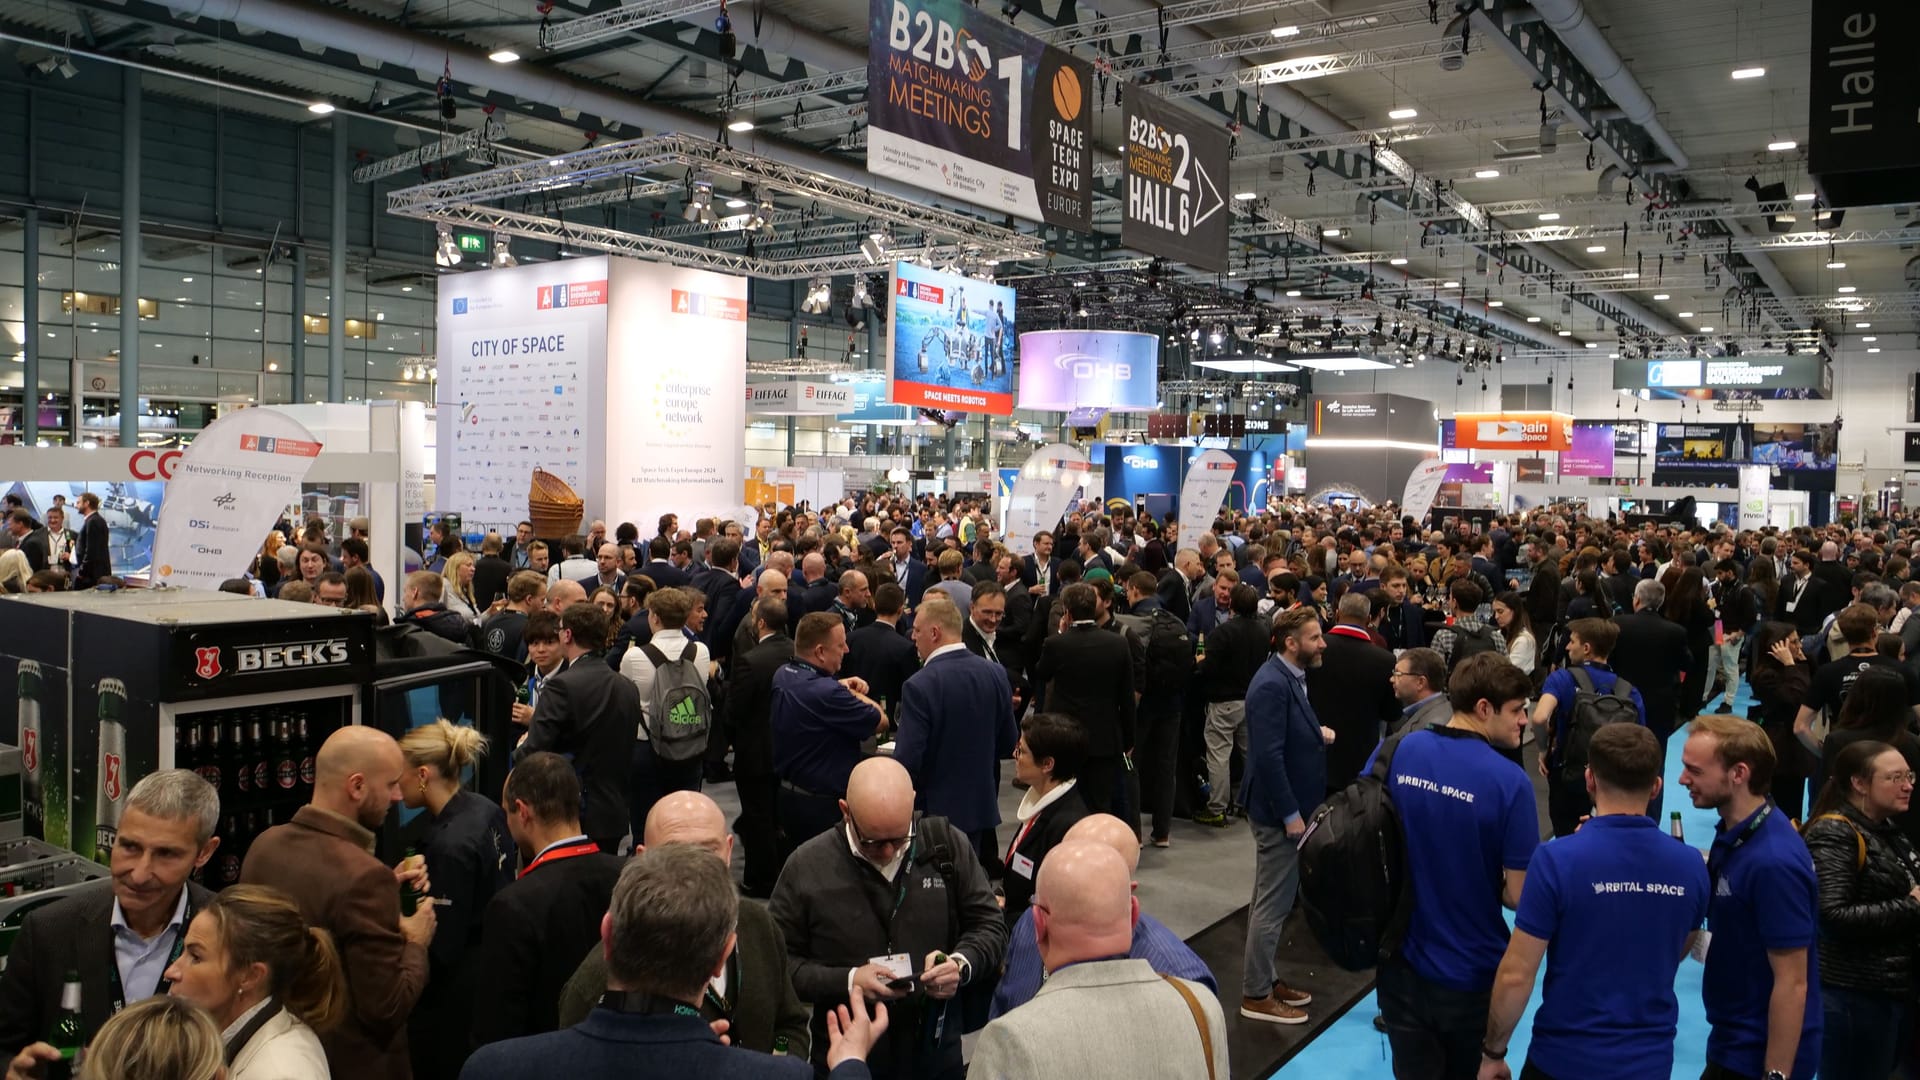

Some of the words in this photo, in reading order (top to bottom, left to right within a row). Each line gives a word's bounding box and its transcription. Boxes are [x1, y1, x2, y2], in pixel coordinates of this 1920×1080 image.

[890, 0, 956, 70] B2B
[889, 53, 992, 108] MATCHMAKING
[1829, 12, 1876, 134] Halle
[889, 76, 991, 139] MEETINGS
[998, 55, 1023, 152] 1
[1050, 119, 1083, 149] SPACE
[1129, 115, 1157, 149] B2B
[1052, 143, 1080, 169] TECH
[1129, 143, 1173, 167] MATCHMAKING
[1172, 134, 1190, 192] 2
[1052, 165, 1079, 191] EXPO
[1129, 156, 1173, 184] MEETINGS
[1047, 192, 1082, 218] EUROPE
[1129, 174, 1174, 232] HALL
[1179, 193, 1190, 236] 6
[471, 339, 499, 357] CITY
[502, 338, 519, 355] OF
[522, 334, 565, 354] SPACE
[1073, 362, 1132, 380] OHB
[665, 383, 711, 398] enterprise
[755, 388, 789, 400] EIFFAGE
[816, 390, 848, 401] EIFFAGE
[924, 390, 942, 400] SPACE
[943, 393, 960, 403] MEETS
[961, 395, 987, 406] ROBOTICS
[665, 398, 698, 411] europe
[665, 411, 703, 424] network
[186, 464, 242, 480] Networking
[244, 470, 292, 483] Reception
[1131, 458, 1159, 469] OHB
[197, 547, 222, 556] OHB
[237, 638, 349, 672] BECK'S
[670, 713, 702, 725] adidas
[1441, 785, 1475, 803] SPACE
[1646, 883, 1685, 897] SPACE
